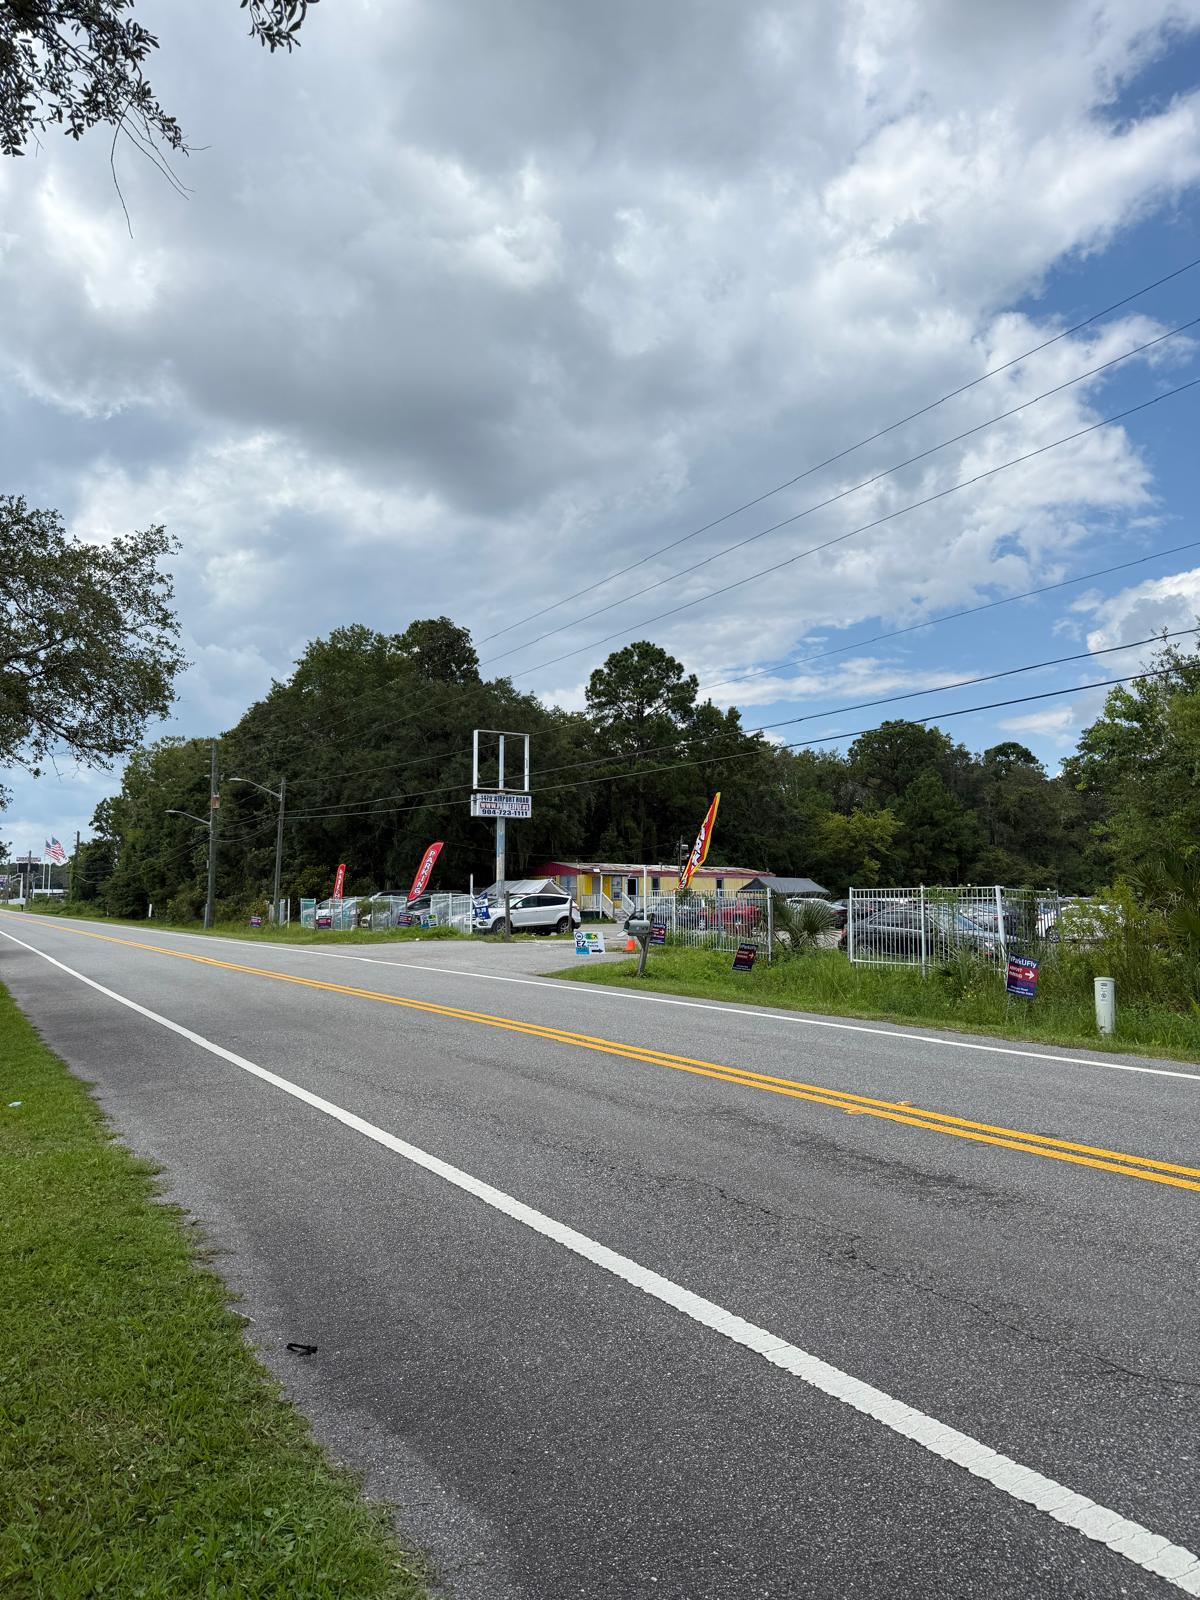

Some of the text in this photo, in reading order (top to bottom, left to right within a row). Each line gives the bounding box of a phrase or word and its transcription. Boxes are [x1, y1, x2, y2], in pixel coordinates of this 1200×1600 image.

[494, 795, 515, 803] AIRPORT
[481, 808, 528, 817] 904-723-1111
[414, 850, 435, 894] PARKING
[576, 940, 587, 948] EZ
